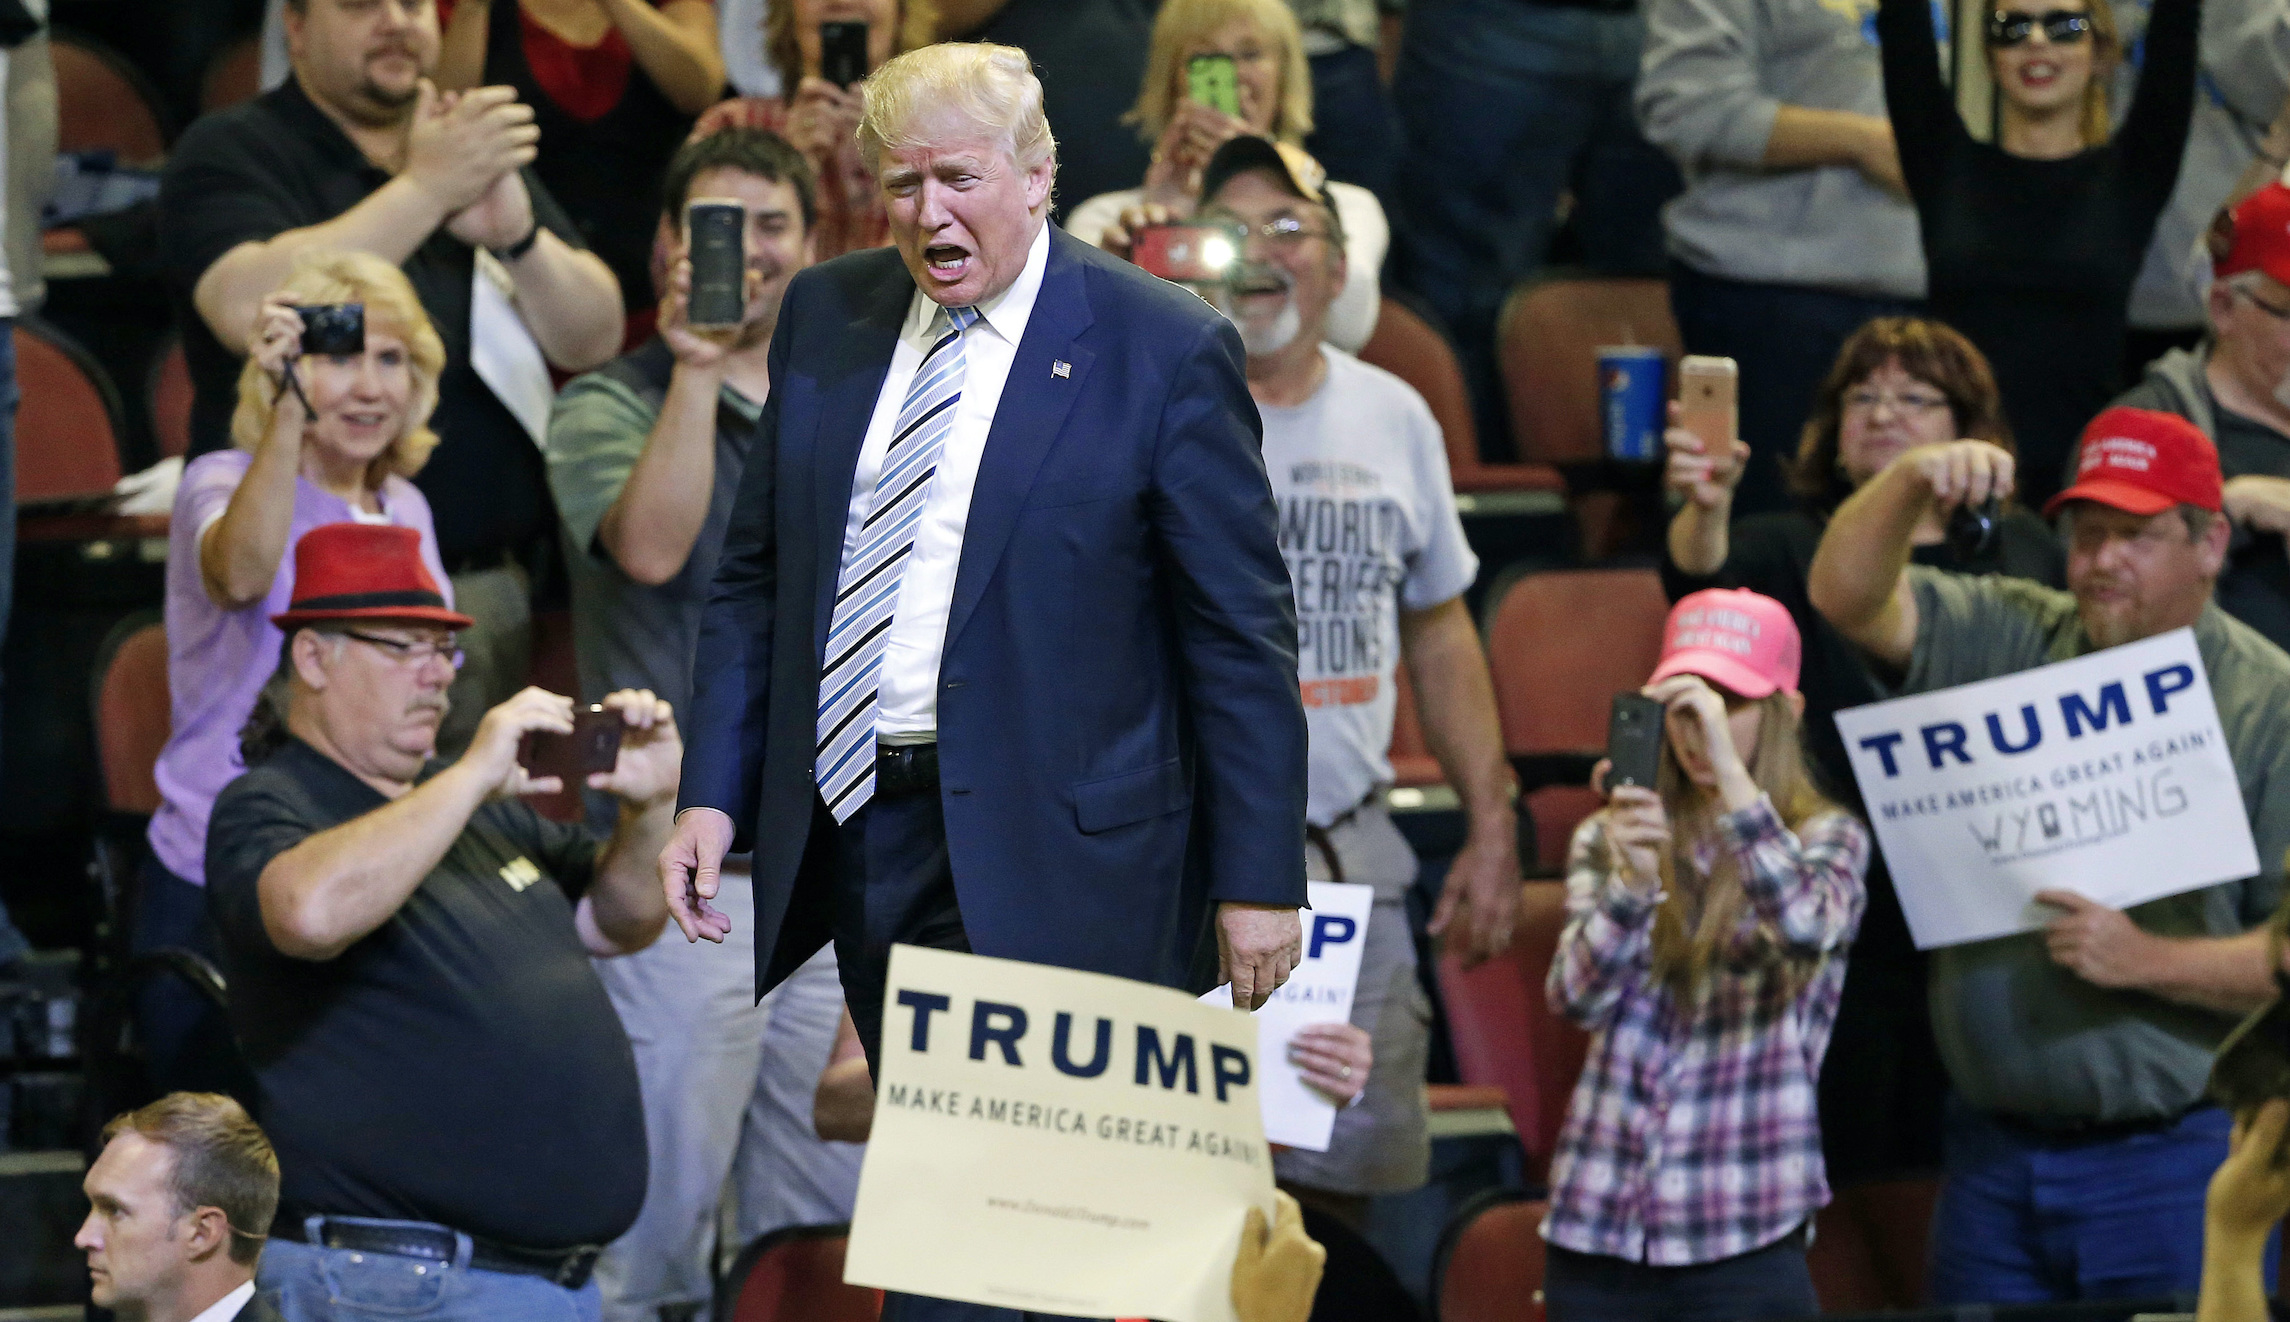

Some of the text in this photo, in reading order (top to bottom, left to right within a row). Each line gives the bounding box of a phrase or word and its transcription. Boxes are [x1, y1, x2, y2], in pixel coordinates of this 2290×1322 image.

[1858, 663, 2196, 778] TRUMP
[1881, 727, 2213, 819] MAKE AMERICA GREAT AGAIN!
[1967, 766, 2188, 851] WYOMING
[897, 987, 1252, 1103] TRUMP
[888, 1083, 960, 1116] MAKE
[969, 1096, 1087, 1135] AMERICA
[1096, 1115, 1179, 1150] GREAT
